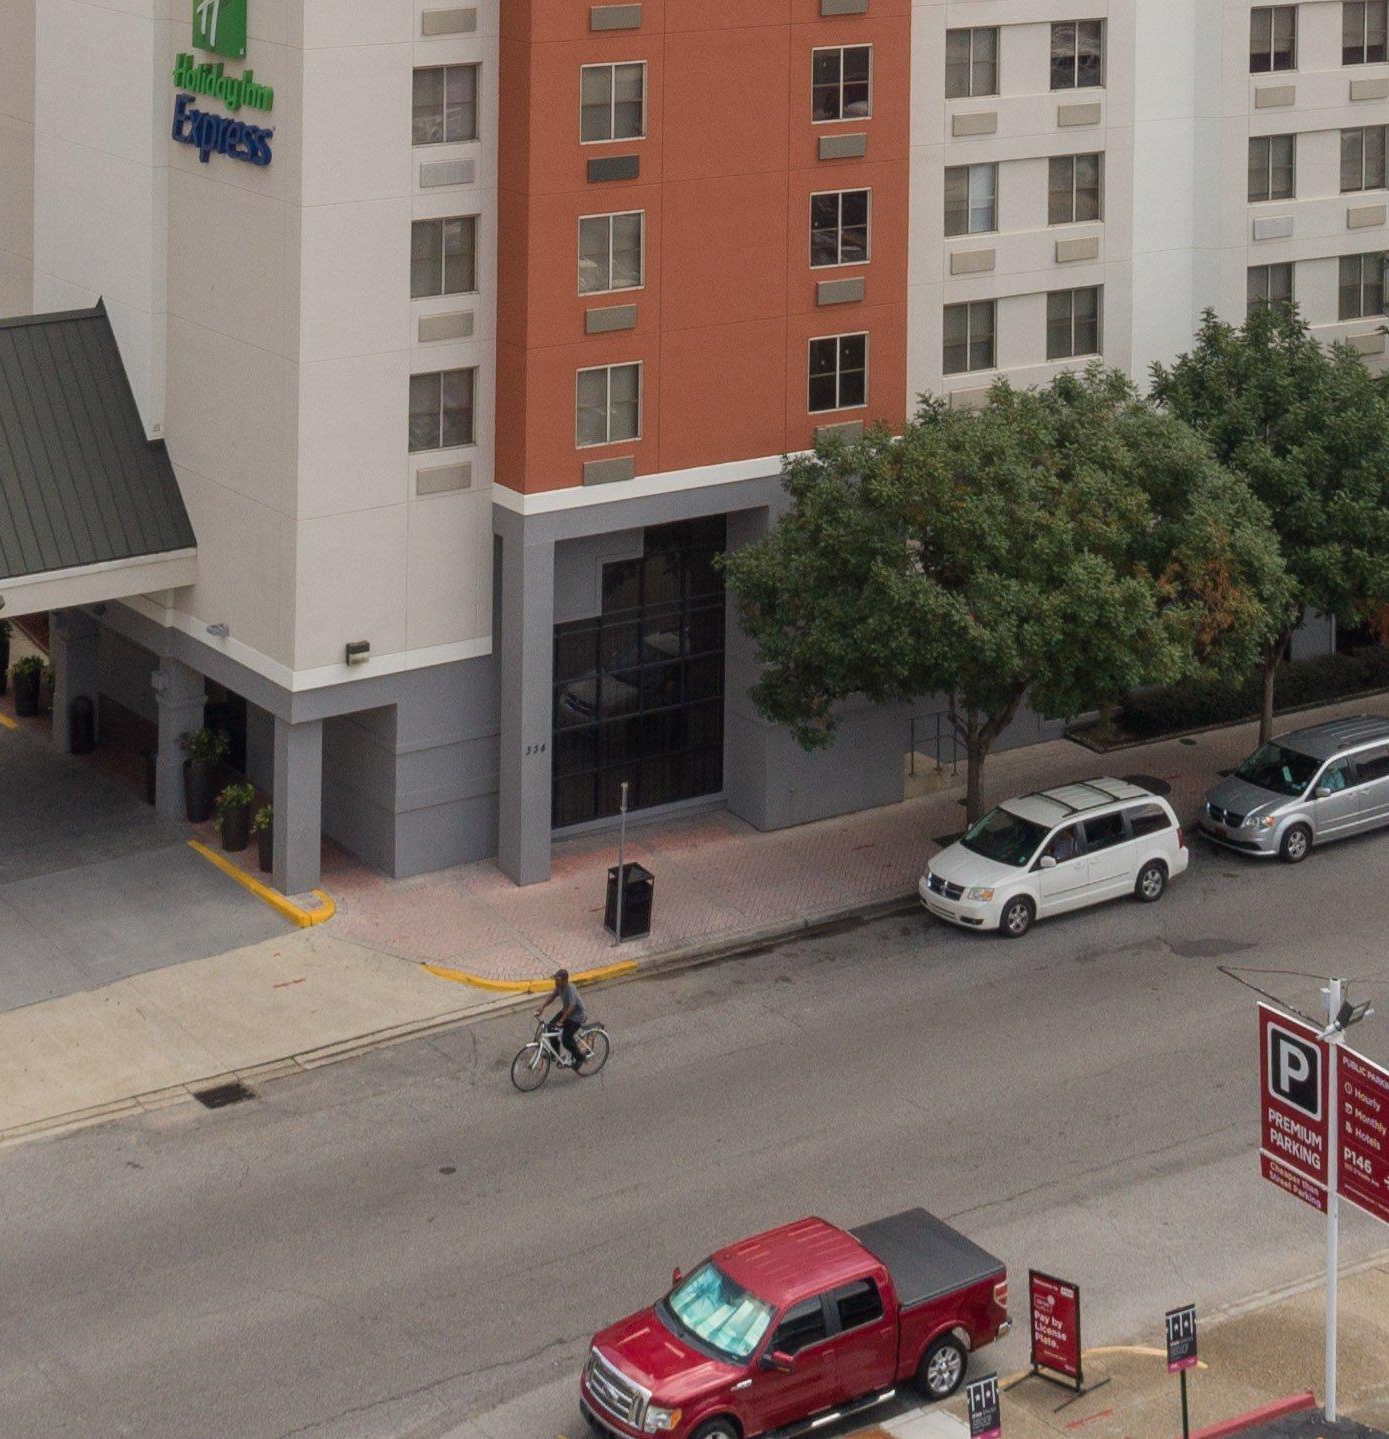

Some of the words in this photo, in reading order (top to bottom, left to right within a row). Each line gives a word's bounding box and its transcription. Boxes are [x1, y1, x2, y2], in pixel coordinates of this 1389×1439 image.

[173, 53, 242, 111] Holiday
[241, 69, 274, 112] Inn
[172, 94, 274, 166] Express
[1279, 1038, 1310, 1094] P
[1342, 1057, 1366, 1077] PUBLIC
[1354, 1087, 1381, 1112] Hourly
[1268, 1108, 1323, 1151] PREMIUM
[1354, 1108, 1387, 1136] Monthly
[1270, 1128, 1321, 1170] PARKING
[1355, 1127, 1382, 1151] Hotels
[1343, 1147, 1373, 1175] P146
[1034, 1310, 1050, 1324] Pay
[1051, 1316, 1063, 1330] by
[1034, 1321, 1067, 1341] License
